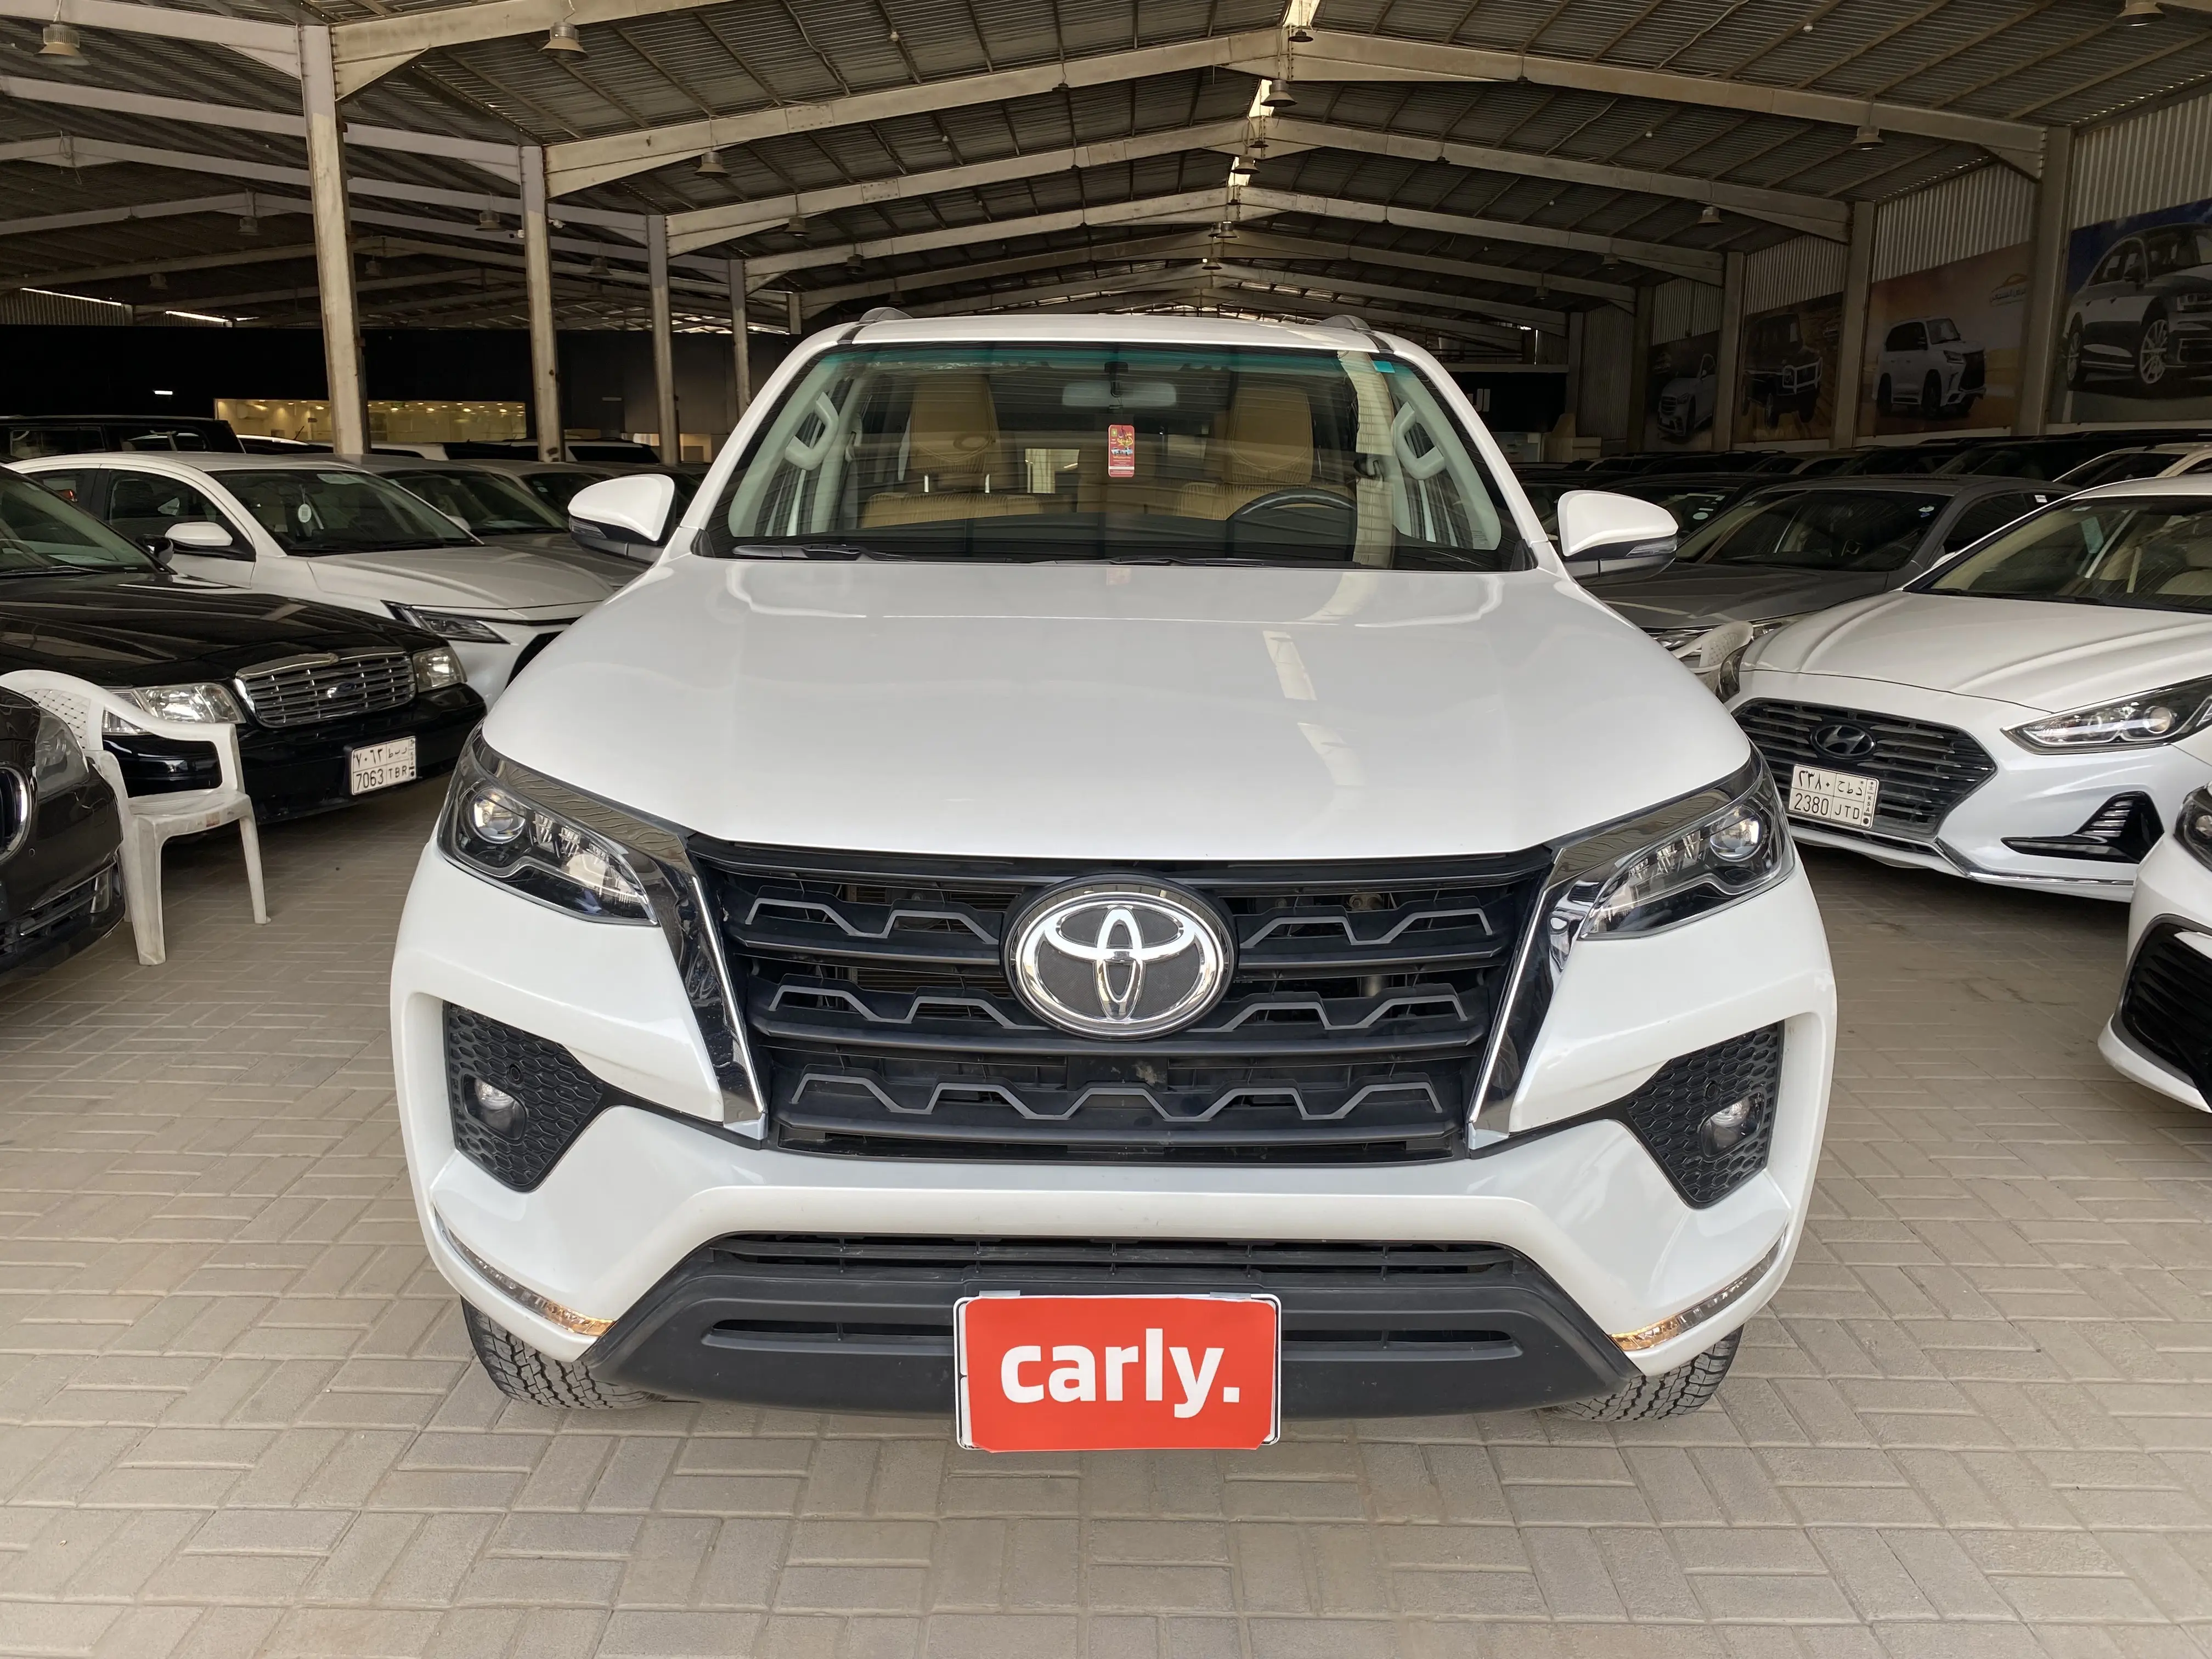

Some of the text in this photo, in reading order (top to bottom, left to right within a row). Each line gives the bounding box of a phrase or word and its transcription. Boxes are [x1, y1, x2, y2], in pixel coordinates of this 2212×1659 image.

[356, 748, 383, 768] ٧٠٦٣
[356, 765, 407, 791] 7063 TBR
[1798, 770, 1830, 791] ٢٣٨٠
[1794, 793, 1860, 820] 2380 JTD
[1001, 1328, 1240, 1418] carly.
